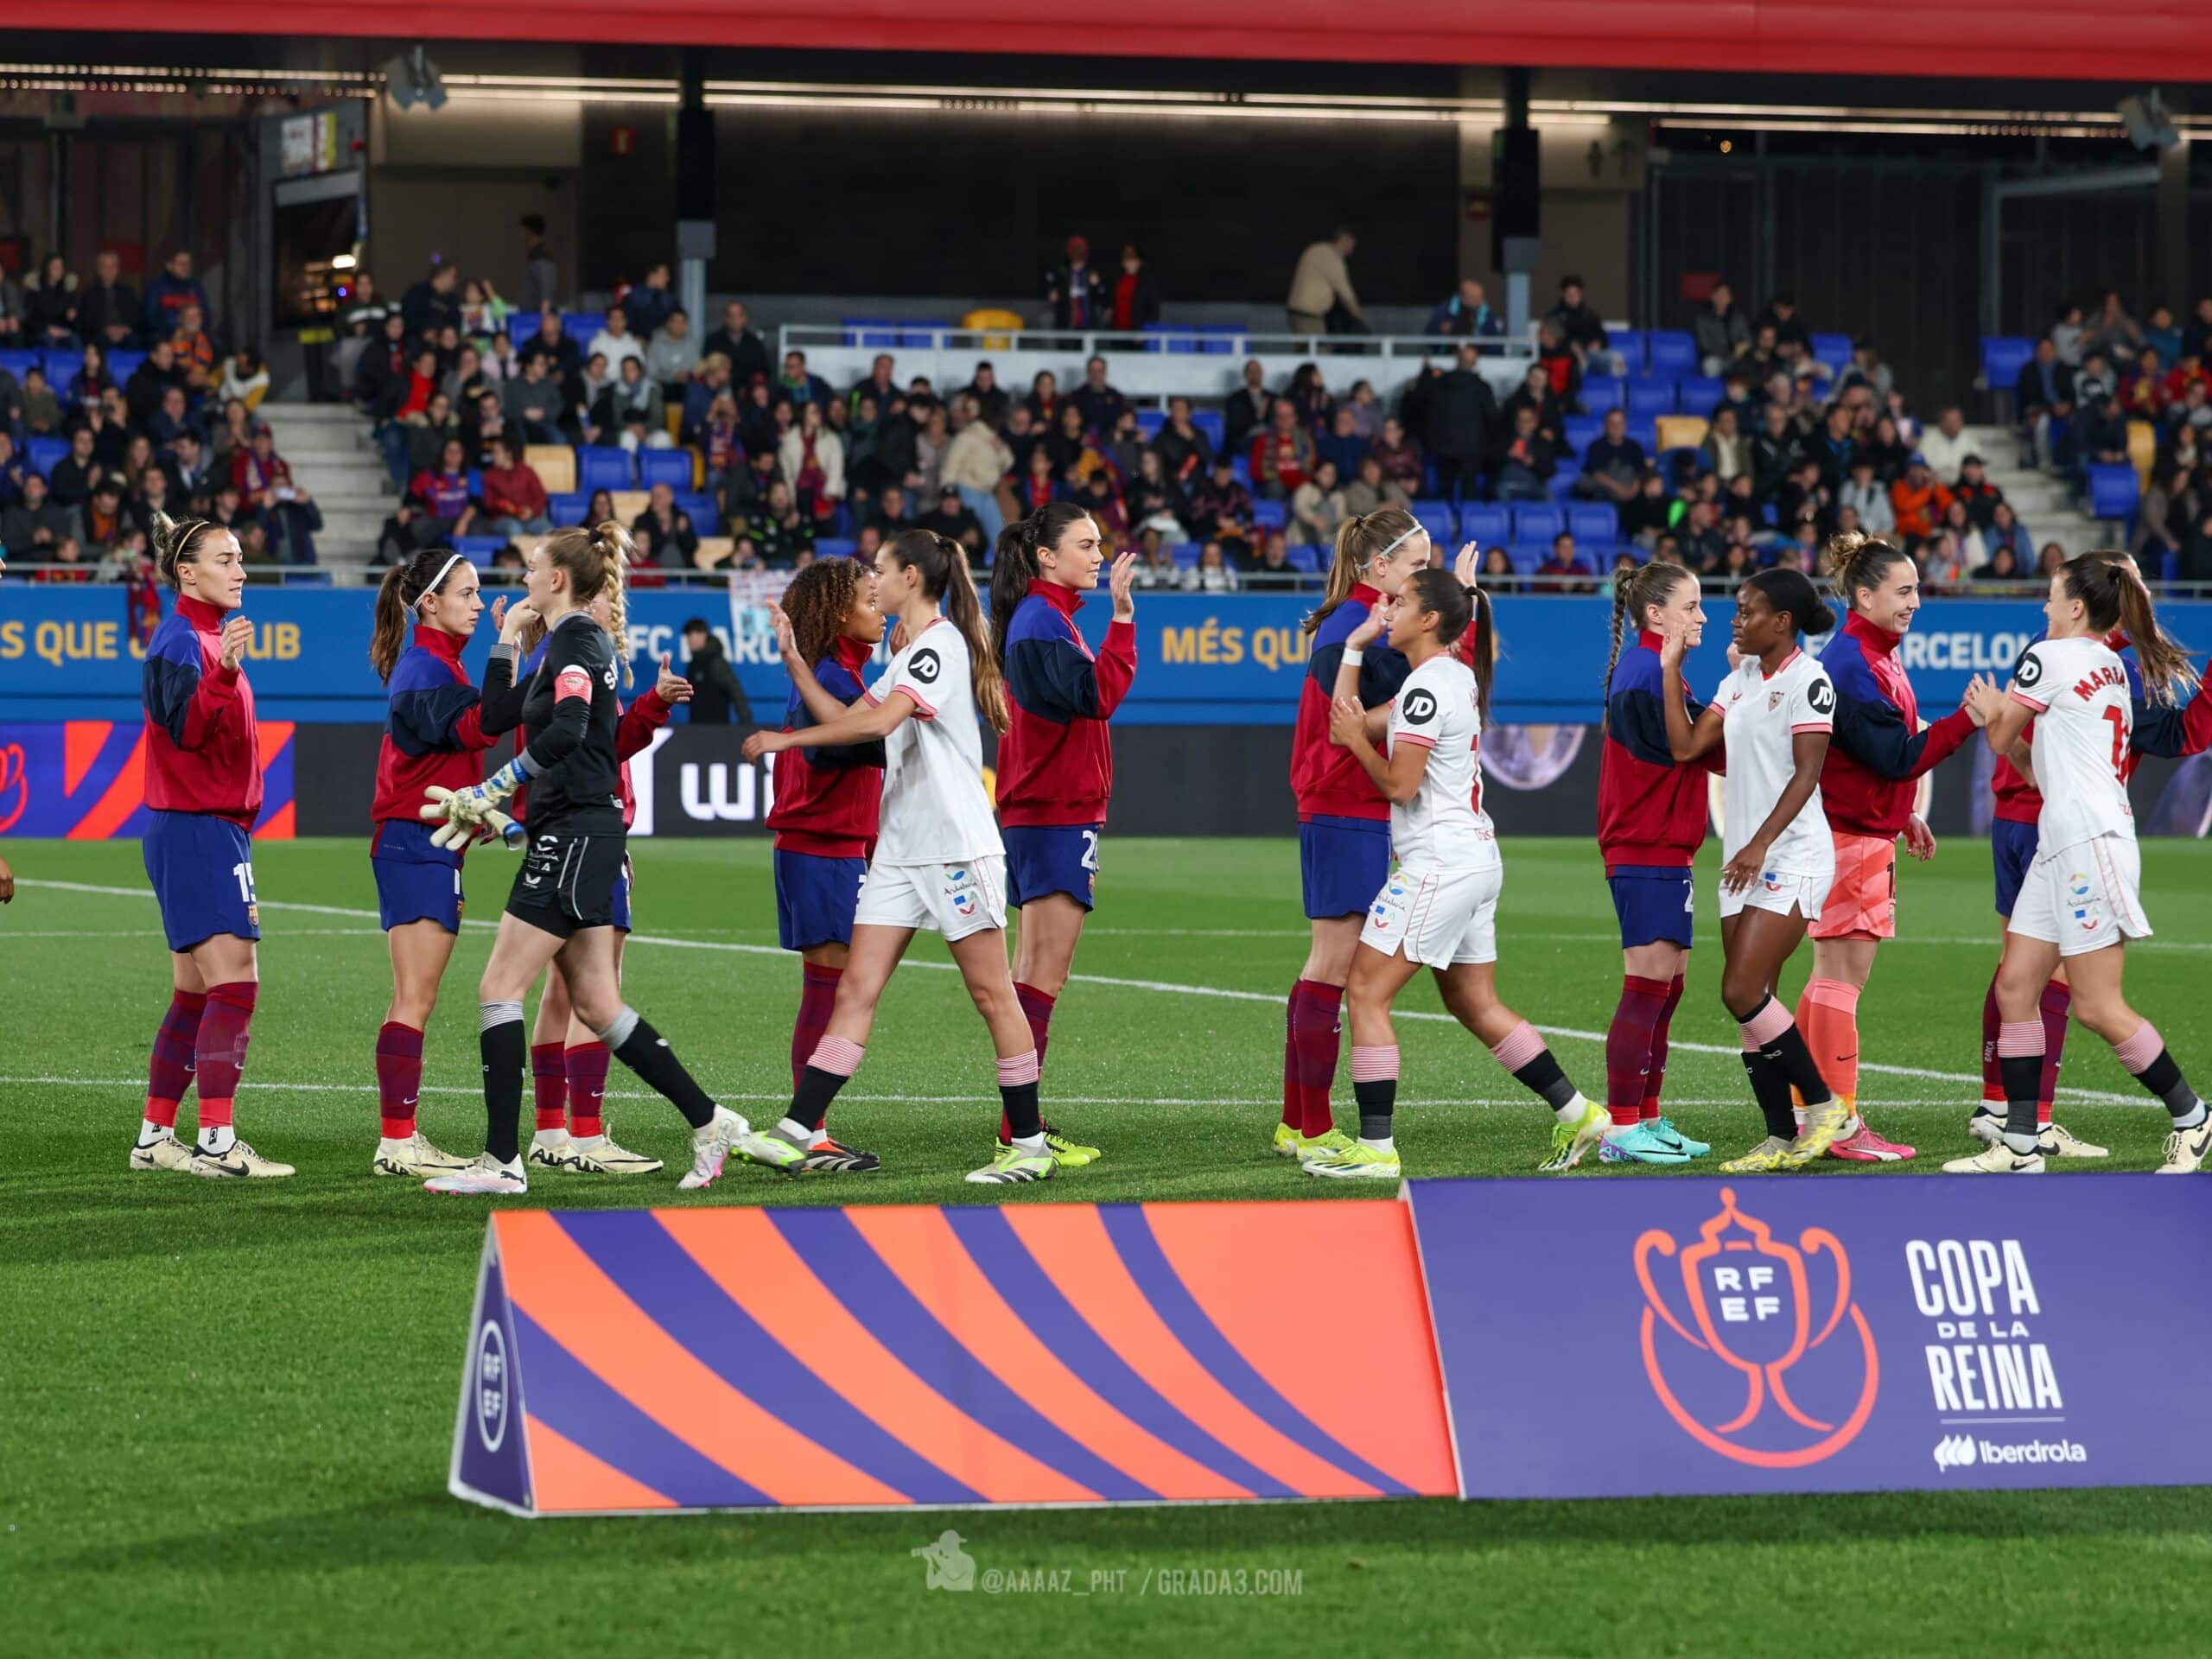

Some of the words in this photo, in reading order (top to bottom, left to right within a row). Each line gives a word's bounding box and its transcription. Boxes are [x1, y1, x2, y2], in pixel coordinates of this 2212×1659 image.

[0, 621, 26, 660] S
[35, 621, 118, 666] QUE
[628, 625, 673, 663] FC
[1161, 616, 1244, 664] MÉS
[2073, 666, 2129, 702] MARIA
[1405, 696, 1434, 717] JD
[1905, 1239, 2042, 1317] COPA
[1936, 1320, 1979, 1339] DE
[1988, 1320, 2031, 1339] LA
[1924, 1344, 2064, 1411] REINA
[1979, 1439, 2088, 1465] Iberdrola
